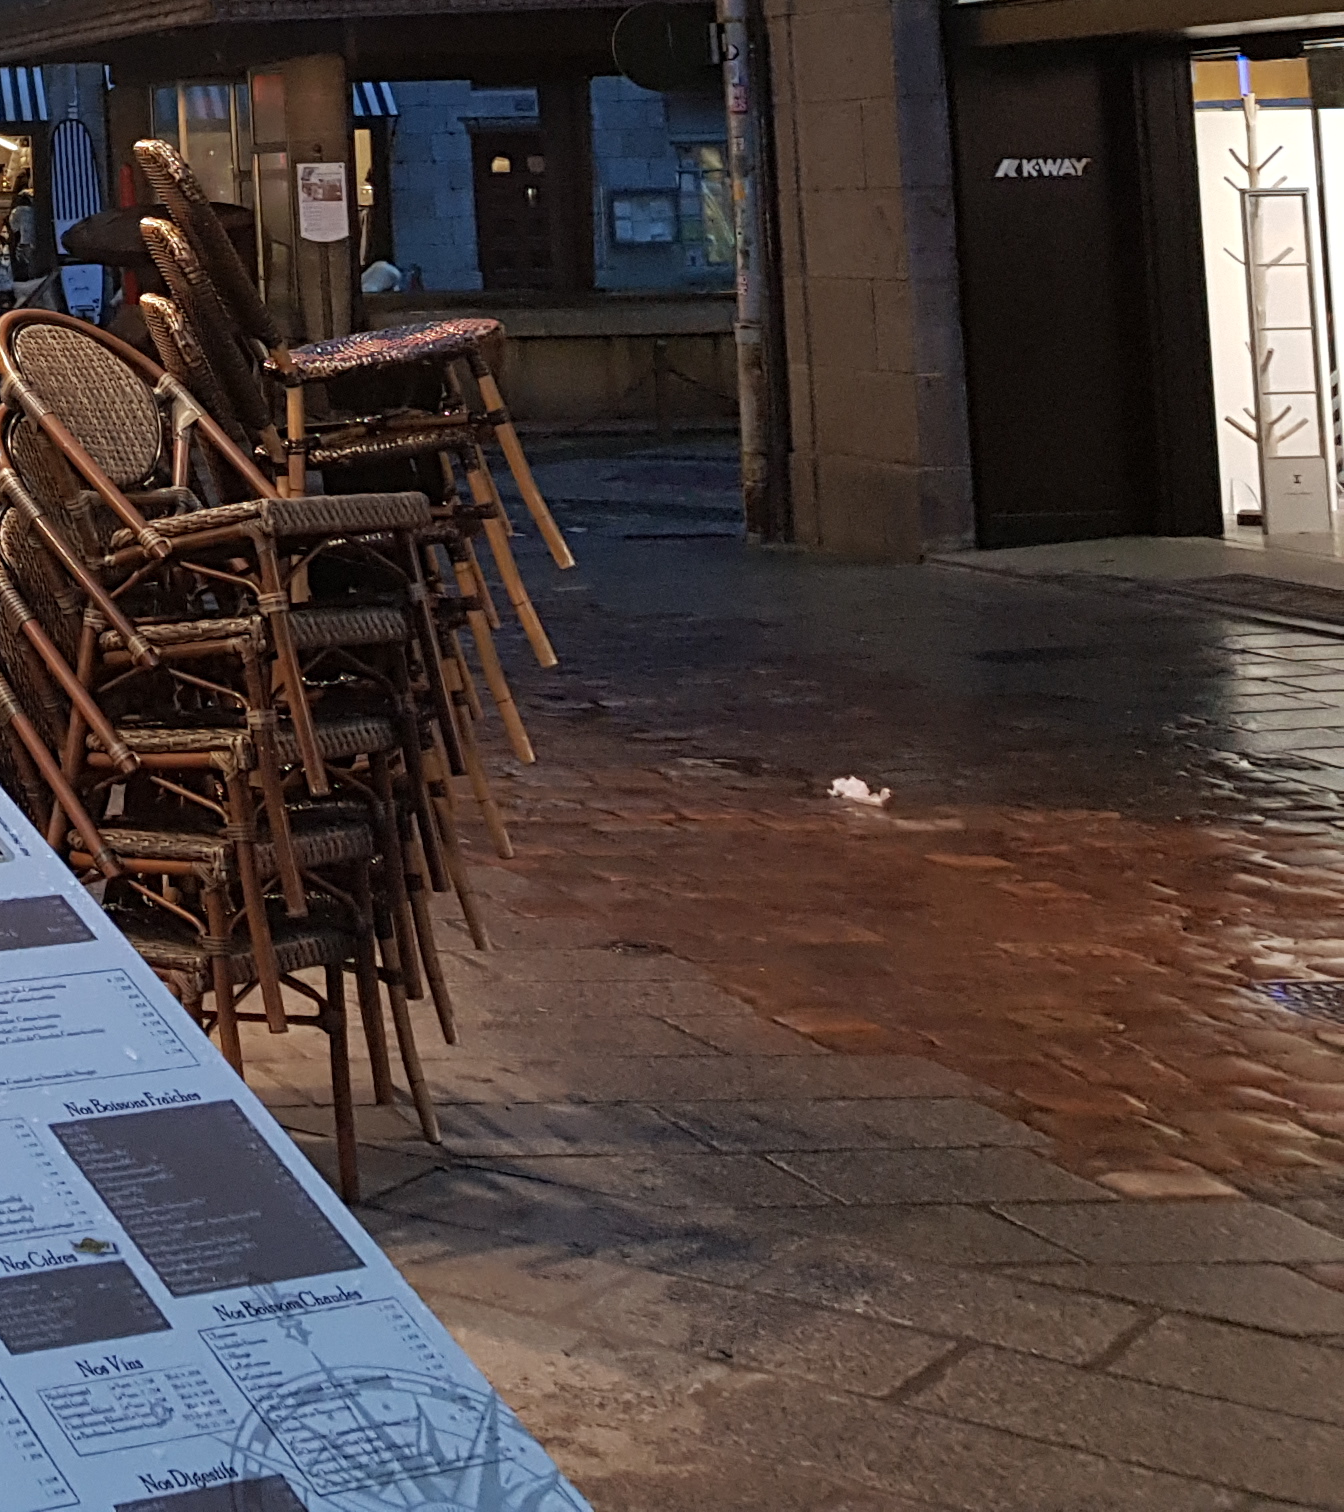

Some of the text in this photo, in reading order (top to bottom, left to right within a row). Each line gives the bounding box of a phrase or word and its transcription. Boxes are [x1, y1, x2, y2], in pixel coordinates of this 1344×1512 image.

[64, 1089, 202, 1117] Nos Boissons Fraîches
[28, 1251, 79, 1269] Cidres
[214, 1303, 243, 1322] Nos
[299, 1287, 364, 1310] Chaudes
[74, 1356, 145, 1378] Nos Vins
[138, 1464, 240, 1493] Nos Digestifs
